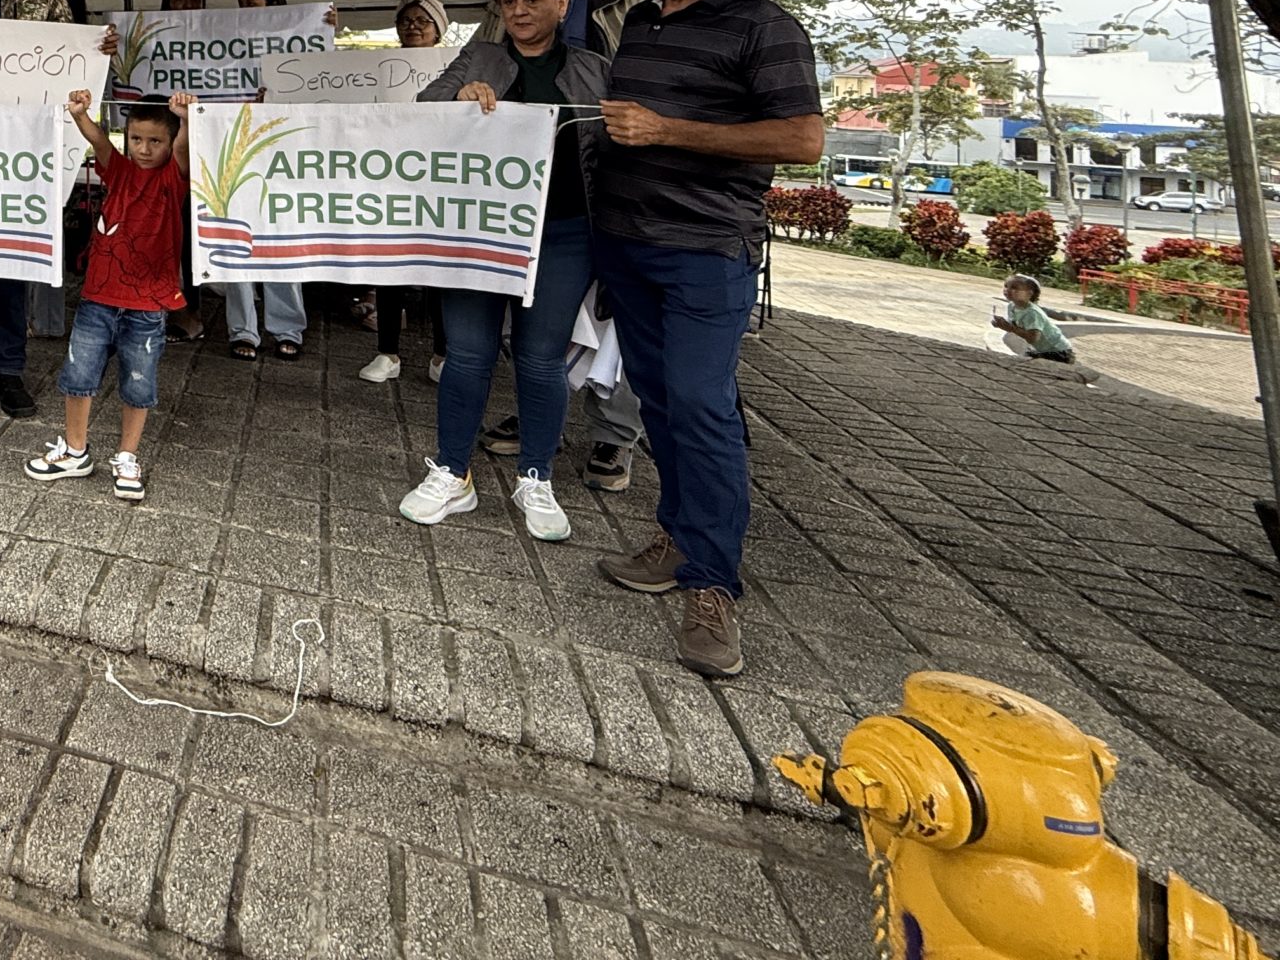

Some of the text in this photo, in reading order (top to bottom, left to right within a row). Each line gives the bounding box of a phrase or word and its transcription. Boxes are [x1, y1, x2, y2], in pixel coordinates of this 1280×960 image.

[151, 34, 326, 62] ARROCEROS
[153, 66, 261, 91] PRESEN
[268, 193, 538, 238] PRESENTES
